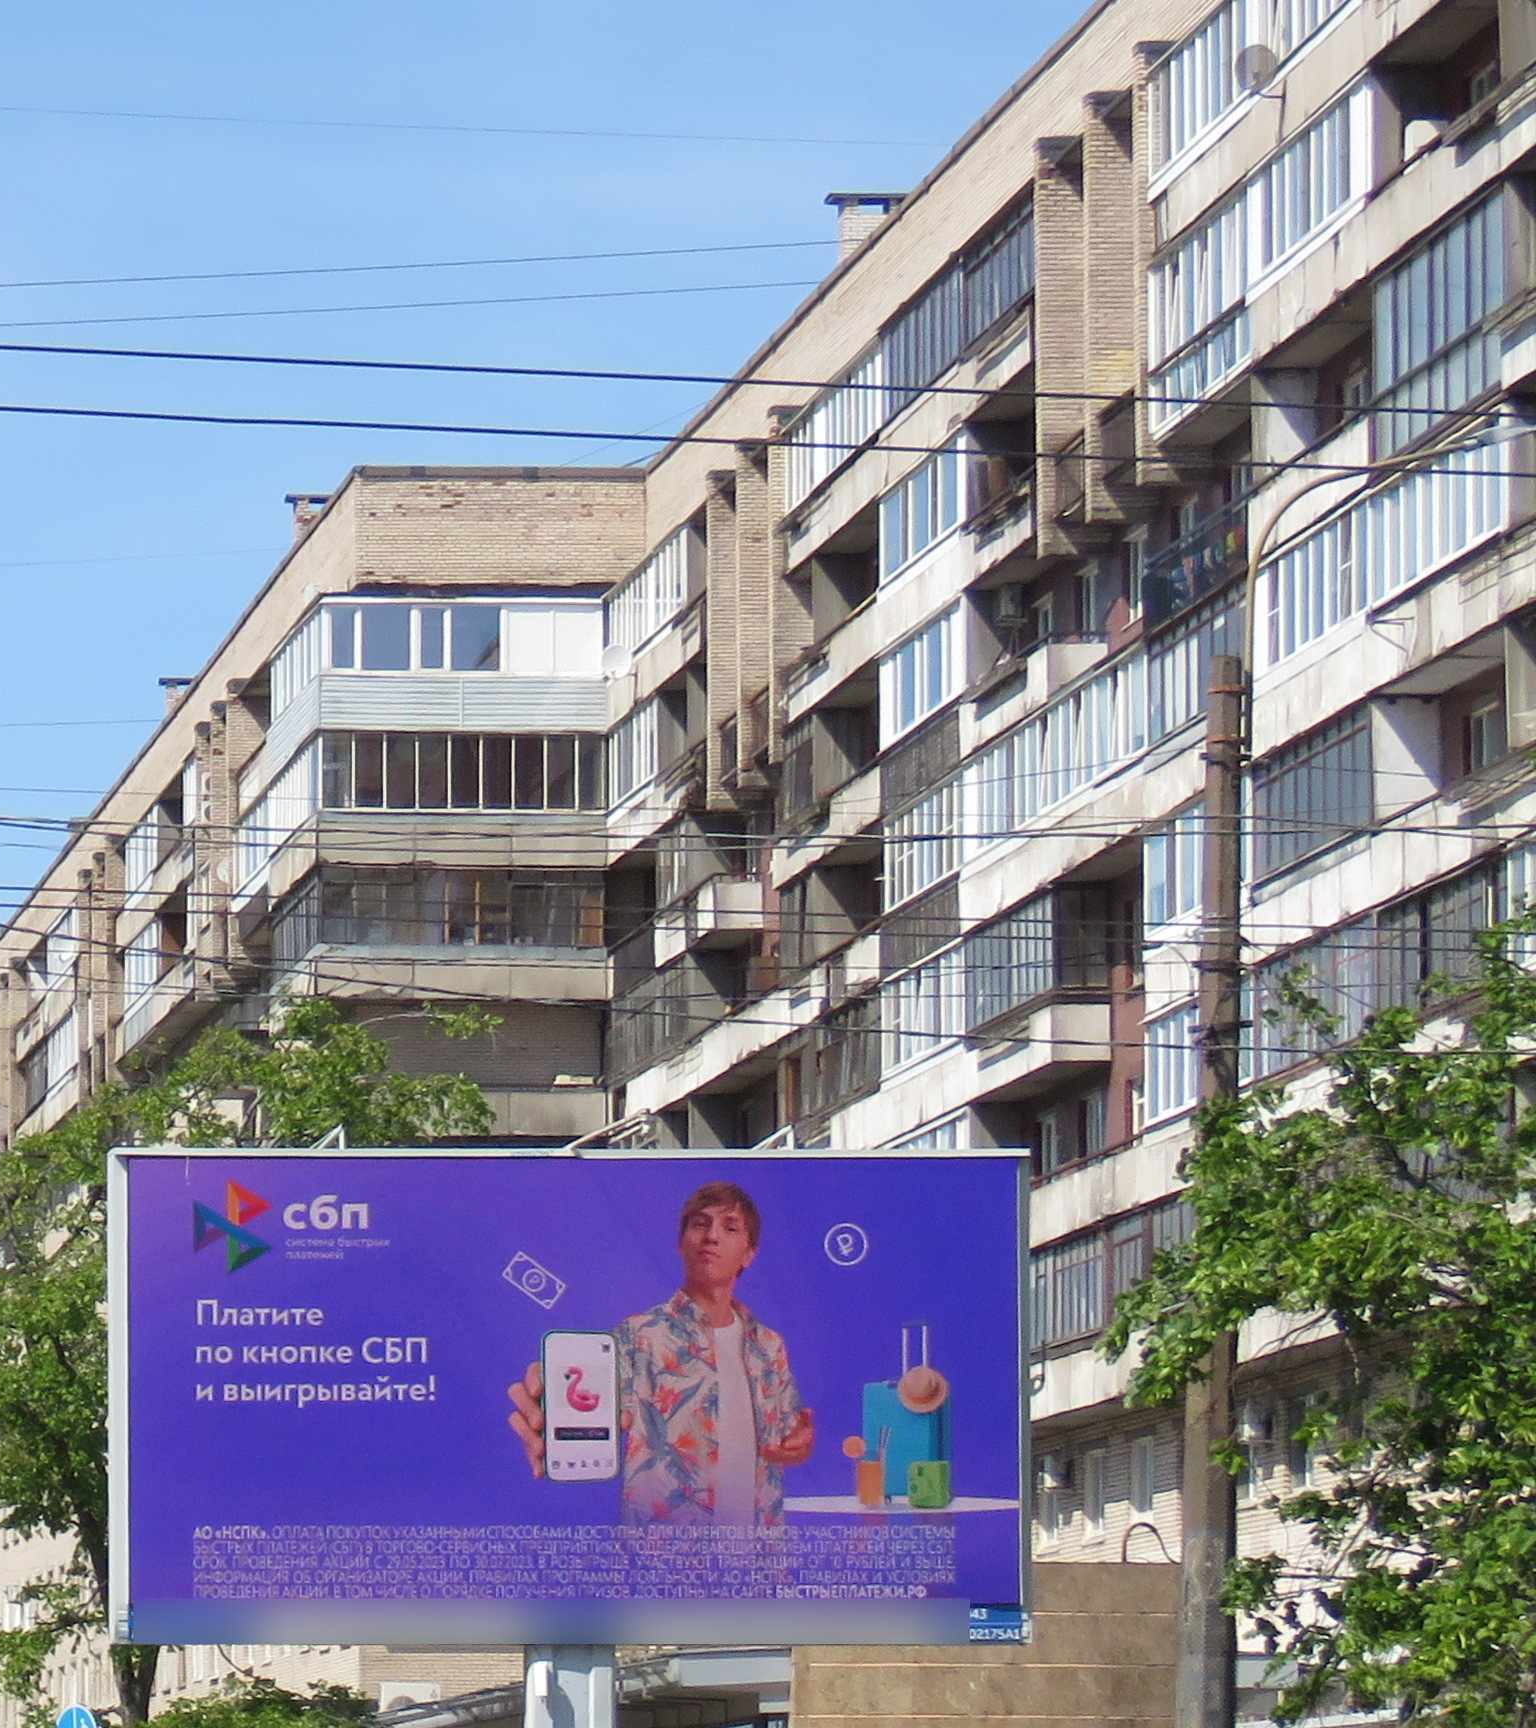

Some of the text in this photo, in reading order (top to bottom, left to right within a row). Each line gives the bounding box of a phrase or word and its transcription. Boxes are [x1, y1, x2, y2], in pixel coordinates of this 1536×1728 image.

[282, 1194, 369, 1230] сбп
[195, 1299, 324, 1326] Платите
[195, 1336, 428, 1365] по кнопке СБП
[195, 1375, 436, 1409] и выигрывайте!
[193, 1525, 212, 1540] АО
